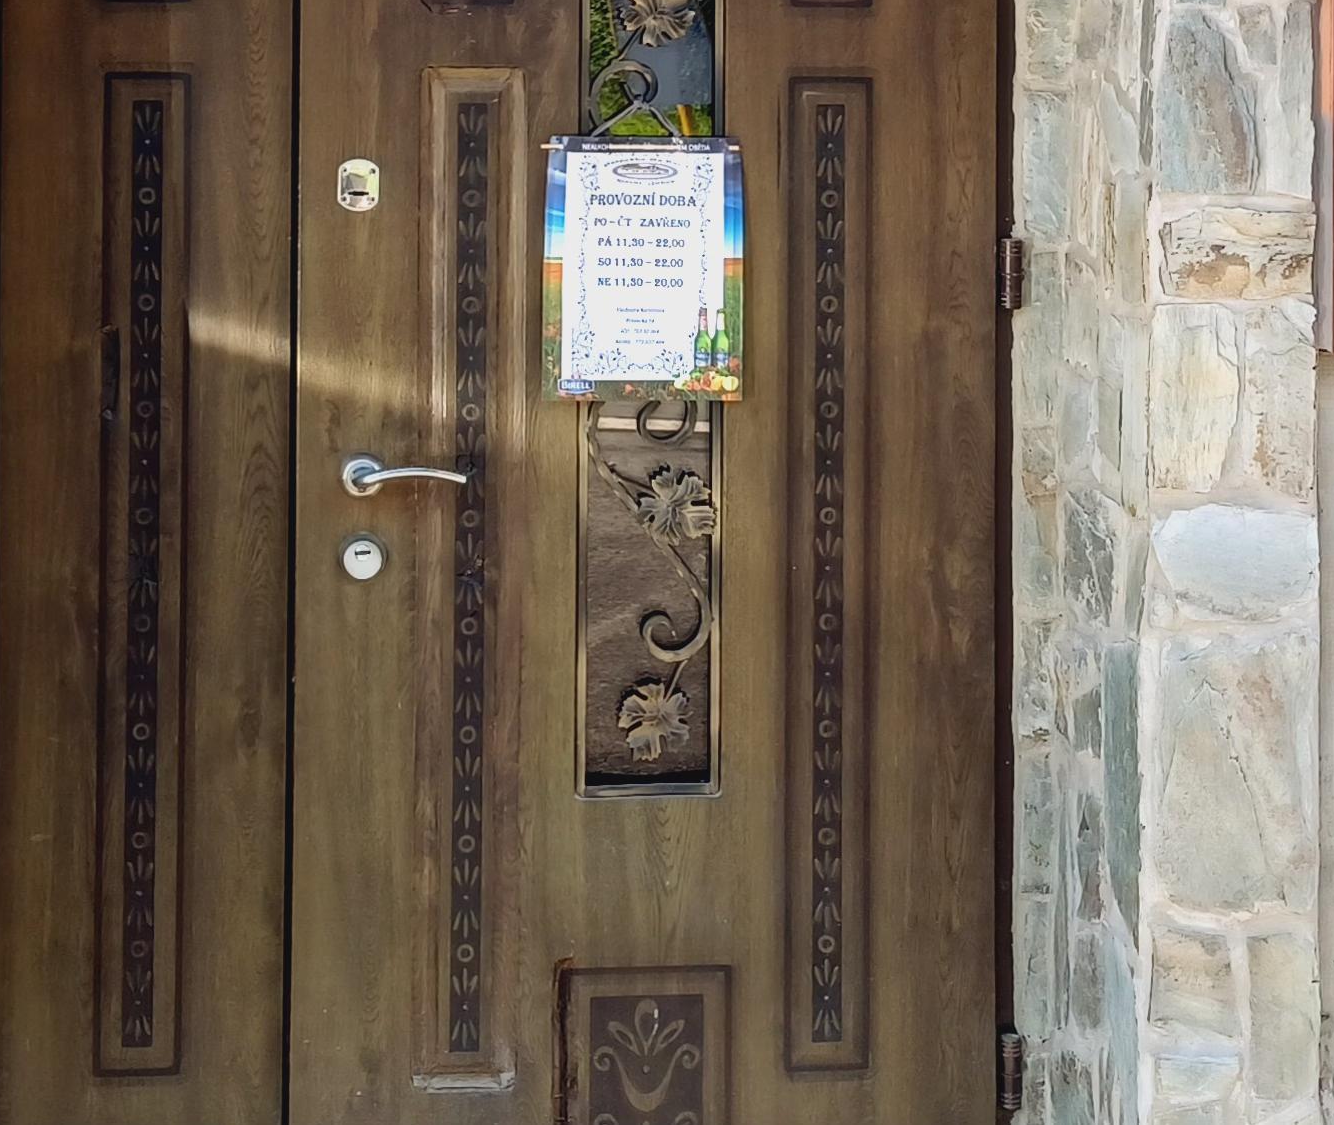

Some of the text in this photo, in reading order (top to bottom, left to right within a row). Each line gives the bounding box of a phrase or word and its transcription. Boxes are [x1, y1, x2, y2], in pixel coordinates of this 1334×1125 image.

[589, 191, 697, 207] PROVOZNÍ DOBA
[639, 216, 691, 229] ZAVŘENO
[597, 235, 613, 247] PÁ
[597, 257, 612, 267] SO
[597, 277, 612, 287] NE
